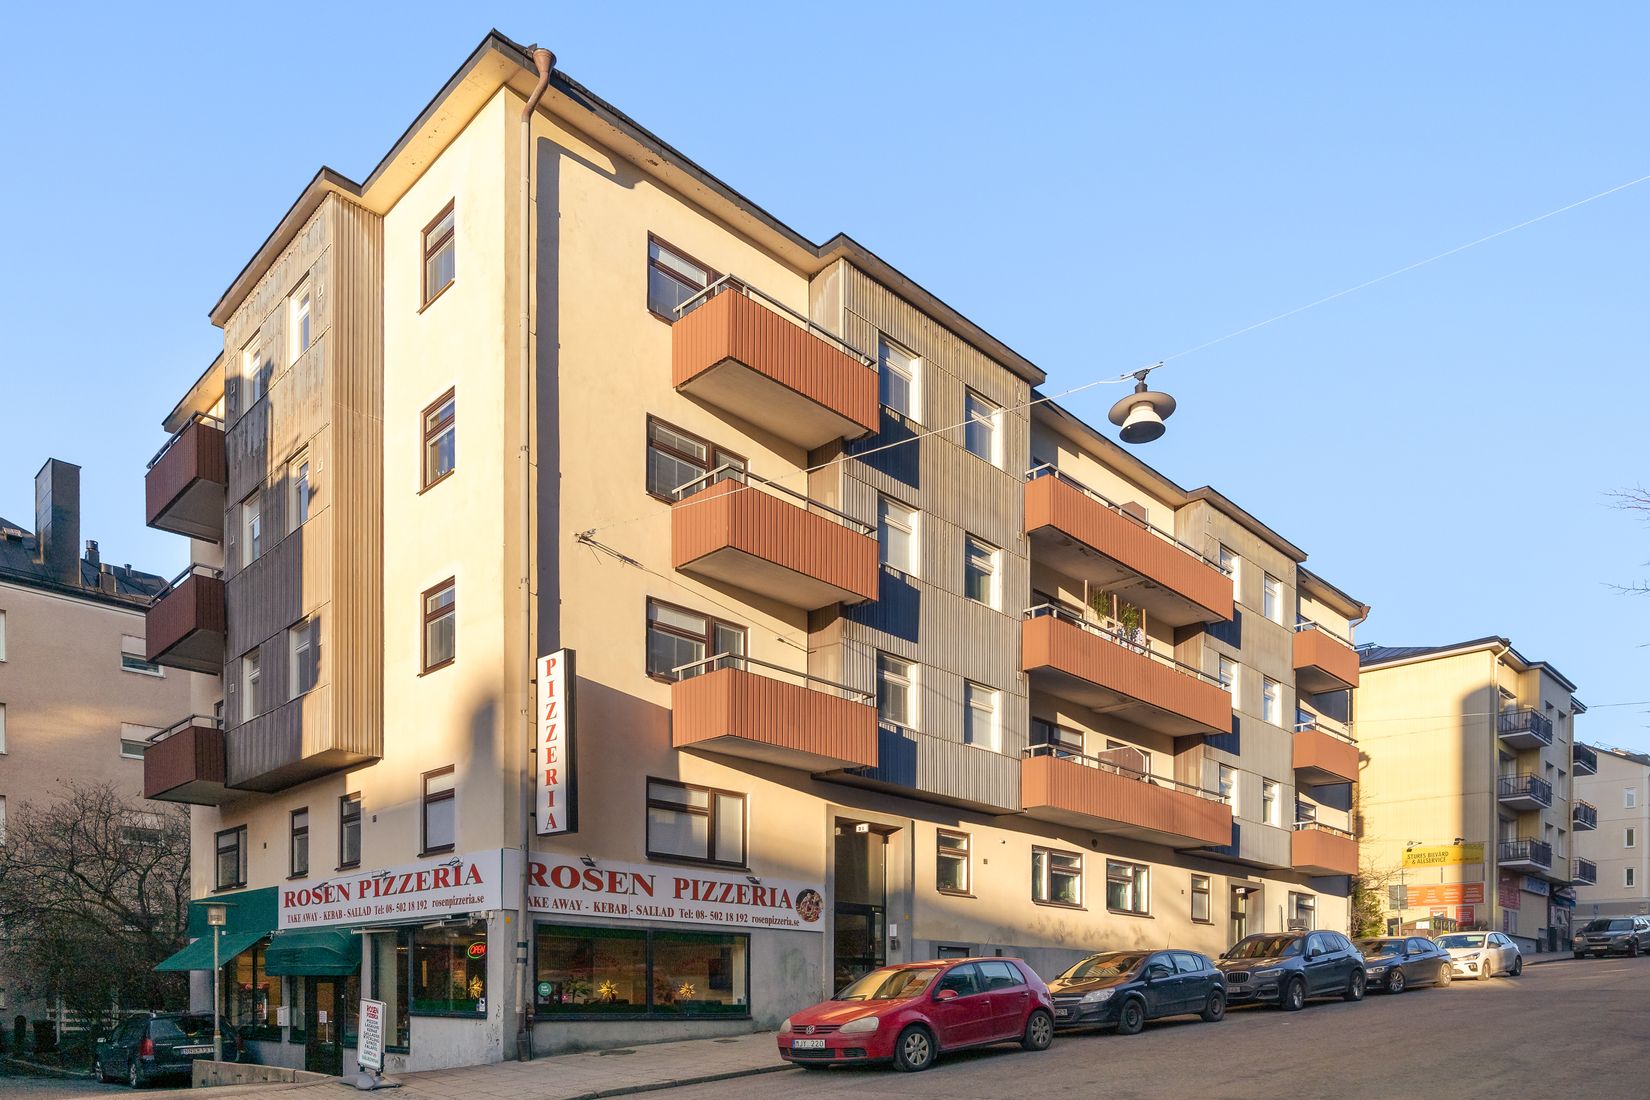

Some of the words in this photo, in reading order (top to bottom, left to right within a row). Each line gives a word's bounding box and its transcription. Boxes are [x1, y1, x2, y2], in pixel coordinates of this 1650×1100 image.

[545, 658, 558, 829] PIZZERIA
[283, 882, 350, 909] ROSEN
[357, 863, 484, 900] PIZZERIA
[527, 861, 656, 898] ROSEN
[672, 876, 794, 909] PIZZERIA
[287, 914, 302, 924] TAKE
[302, 911, 319, 922] AWAY
[323, 909, 343, 921] KEBAB
[347, 905, 372, 918] SALLAD
[375, 905, 384, 916] Tel:
[396, 902, 407, 913] 502
[408, 901, 415, 912] 18
[416, 900, 428, 911] 192
[432, 893, 485, 909] rosenpizzeria.se
[527, 895, 549, 908] AKE
[551, 898, 583, 911] AWAY
[593, 901, 628, 915] KEBAB
[635, 904, 675, 918] SALLAD
[679, 908, 694, 919] Tel:
[709, 911, 723, 921] 502
[725, 912, 734, 922] 18
[736, 913, 748, 923] 192
[751, 915, 800, 927] rosenpizzeria.se
[470, 944, 487, 955] OPEN
